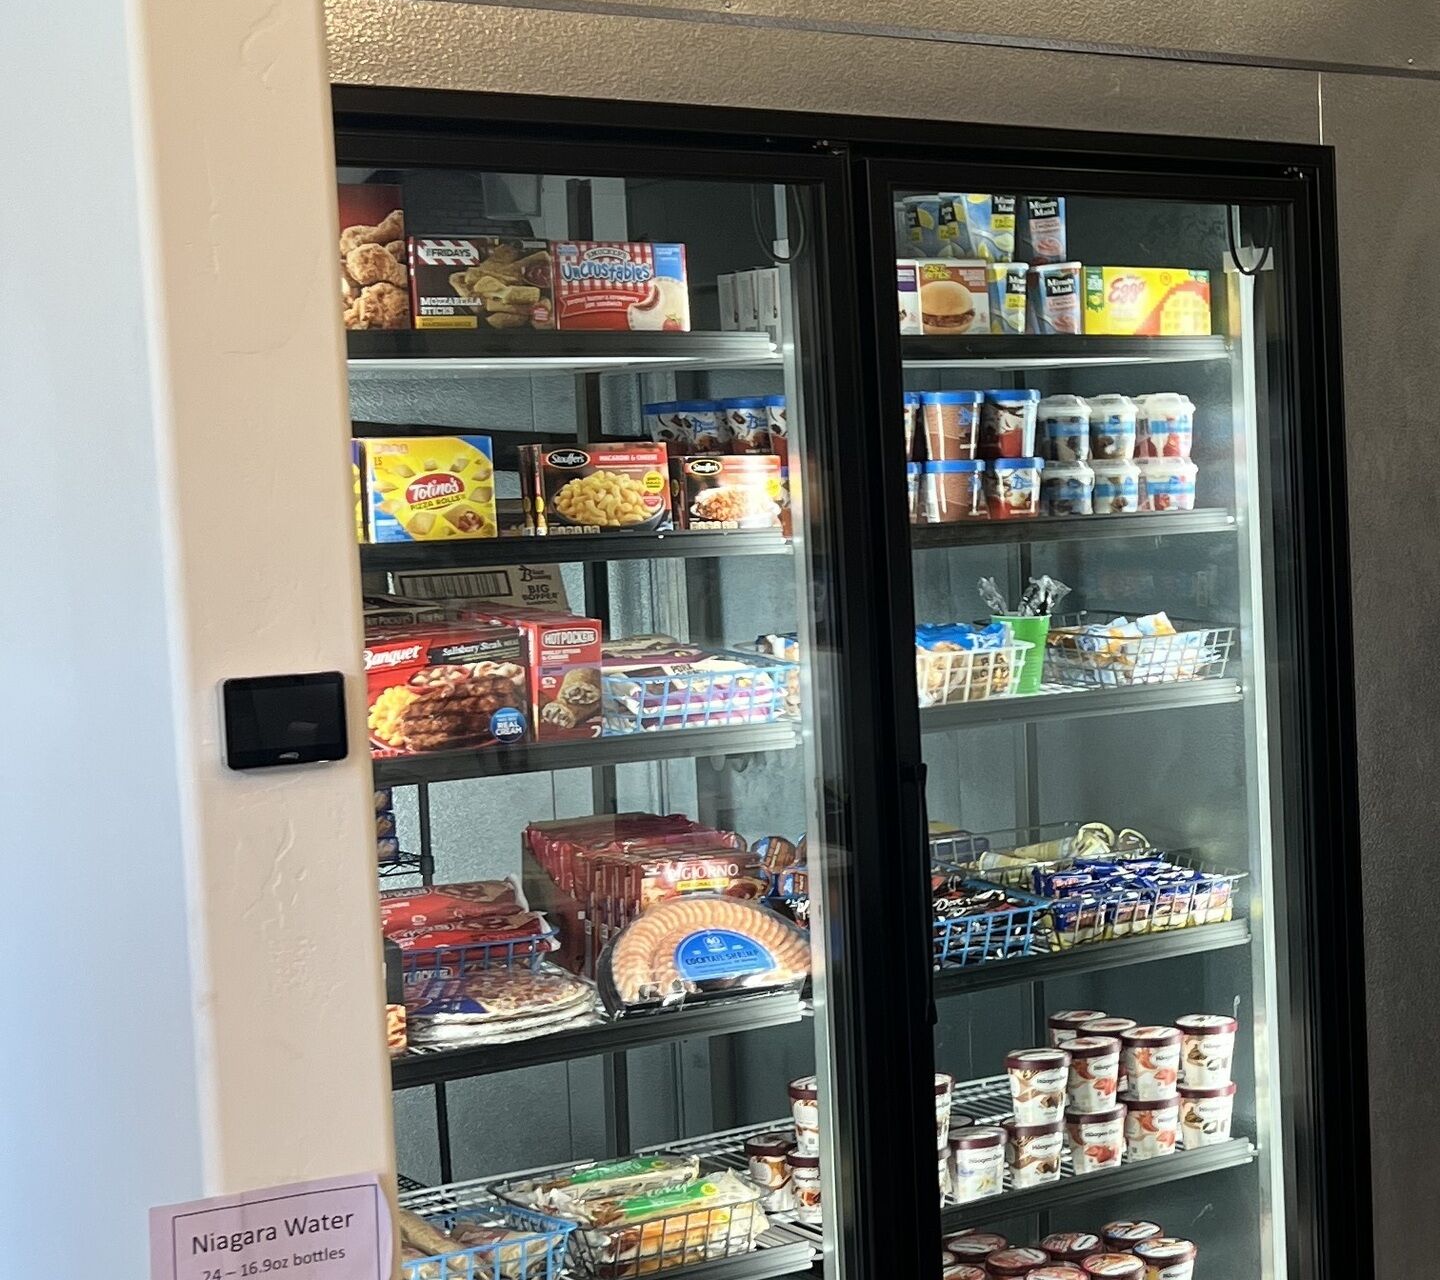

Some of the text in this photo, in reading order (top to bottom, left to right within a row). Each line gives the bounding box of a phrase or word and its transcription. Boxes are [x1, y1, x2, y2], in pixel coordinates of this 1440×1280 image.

[1029, 200, 1057, 210] Minute
[1035, 208, 1056, 216] Maid
[431, 248, 472, 257] FRIDAYS
[561, 260, 652, 281] Uncrustables
[1048, 277, 1074, 287] Minute
[1052, 286, 1073, 294] Maid
[420, 297, 482, 306] MOZZARELLA
[420, 307, 455, 315] STICKS
[551, 453, 585, 465] Stouffer's
[409, 478, 459, 501] Totino's
[410, 496, 461, 511] PIZZA ROLLS
[527, 584, 550, 594] BIG
[544, 630, 595, 645] HOT POCKETS
[442, 644, 479, 657] Salisbury
[480, 640, 503, 651] Steak
[363, 646, 423, 669] Banquet
[497, 721, 520, 729] REAL
[495, 727, 523, 736] CREAM
[685, 950, 760, 966] COCKTAIL SHRIMP
[192, 1213, 354, 1255] Niagara Water
[241, 1257, 288, 1277] 16.9oz
[293, 1248, 346, 1266] bottles
